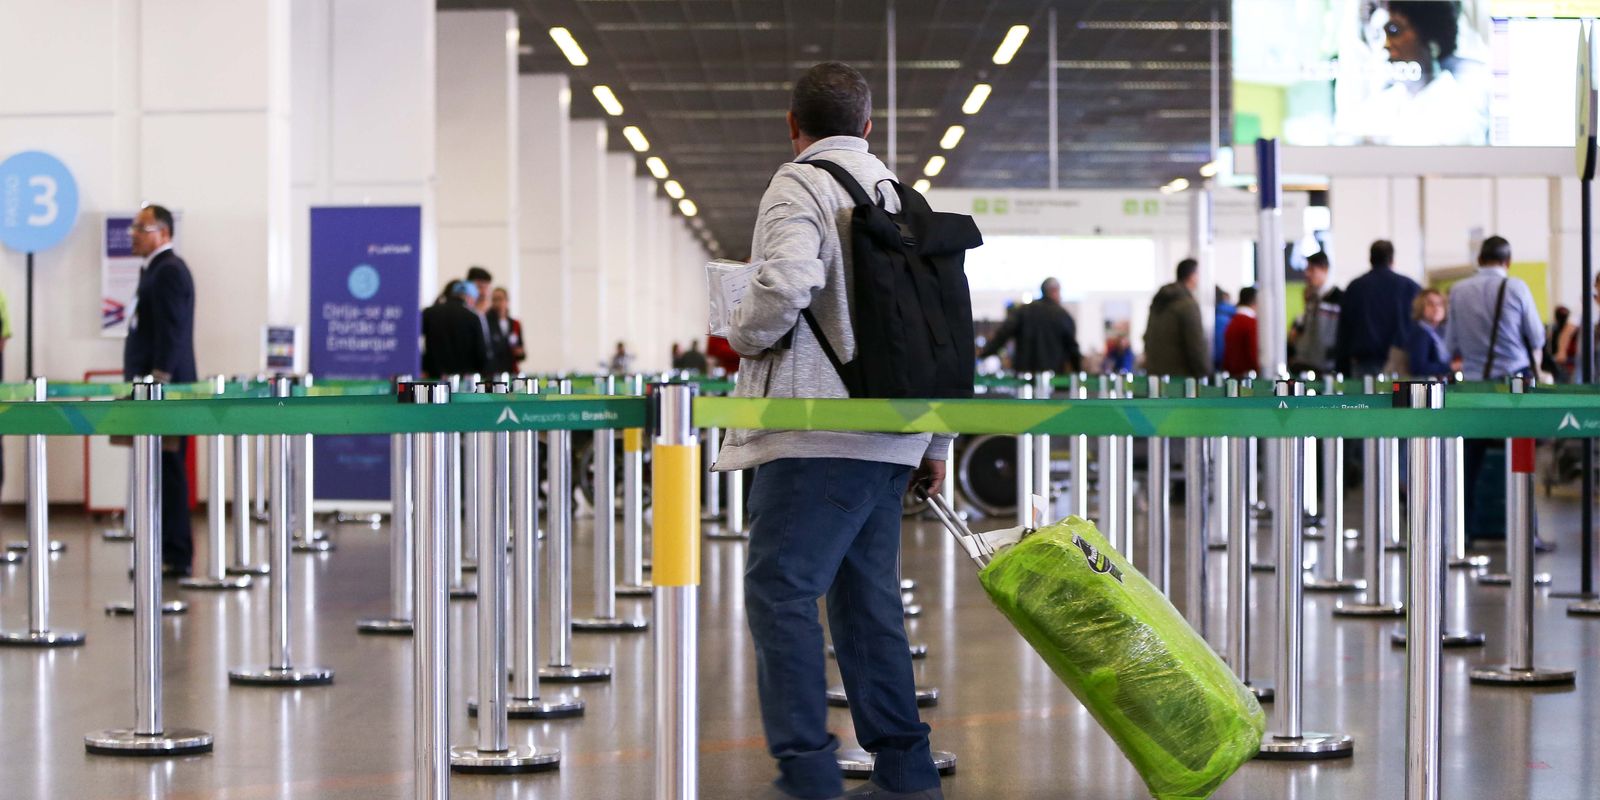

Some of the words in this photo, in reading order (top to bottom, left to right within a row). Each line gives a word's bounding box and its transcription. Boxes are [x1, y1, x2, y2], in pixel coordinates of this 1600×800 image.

[28, 175, 58, 226] 3
[378, 320, 396, 335] de
[326, 336, 398, 353] Embarque
[522, 412, 565, 423] Aeroporto
[568, 411, 579, 421] de
